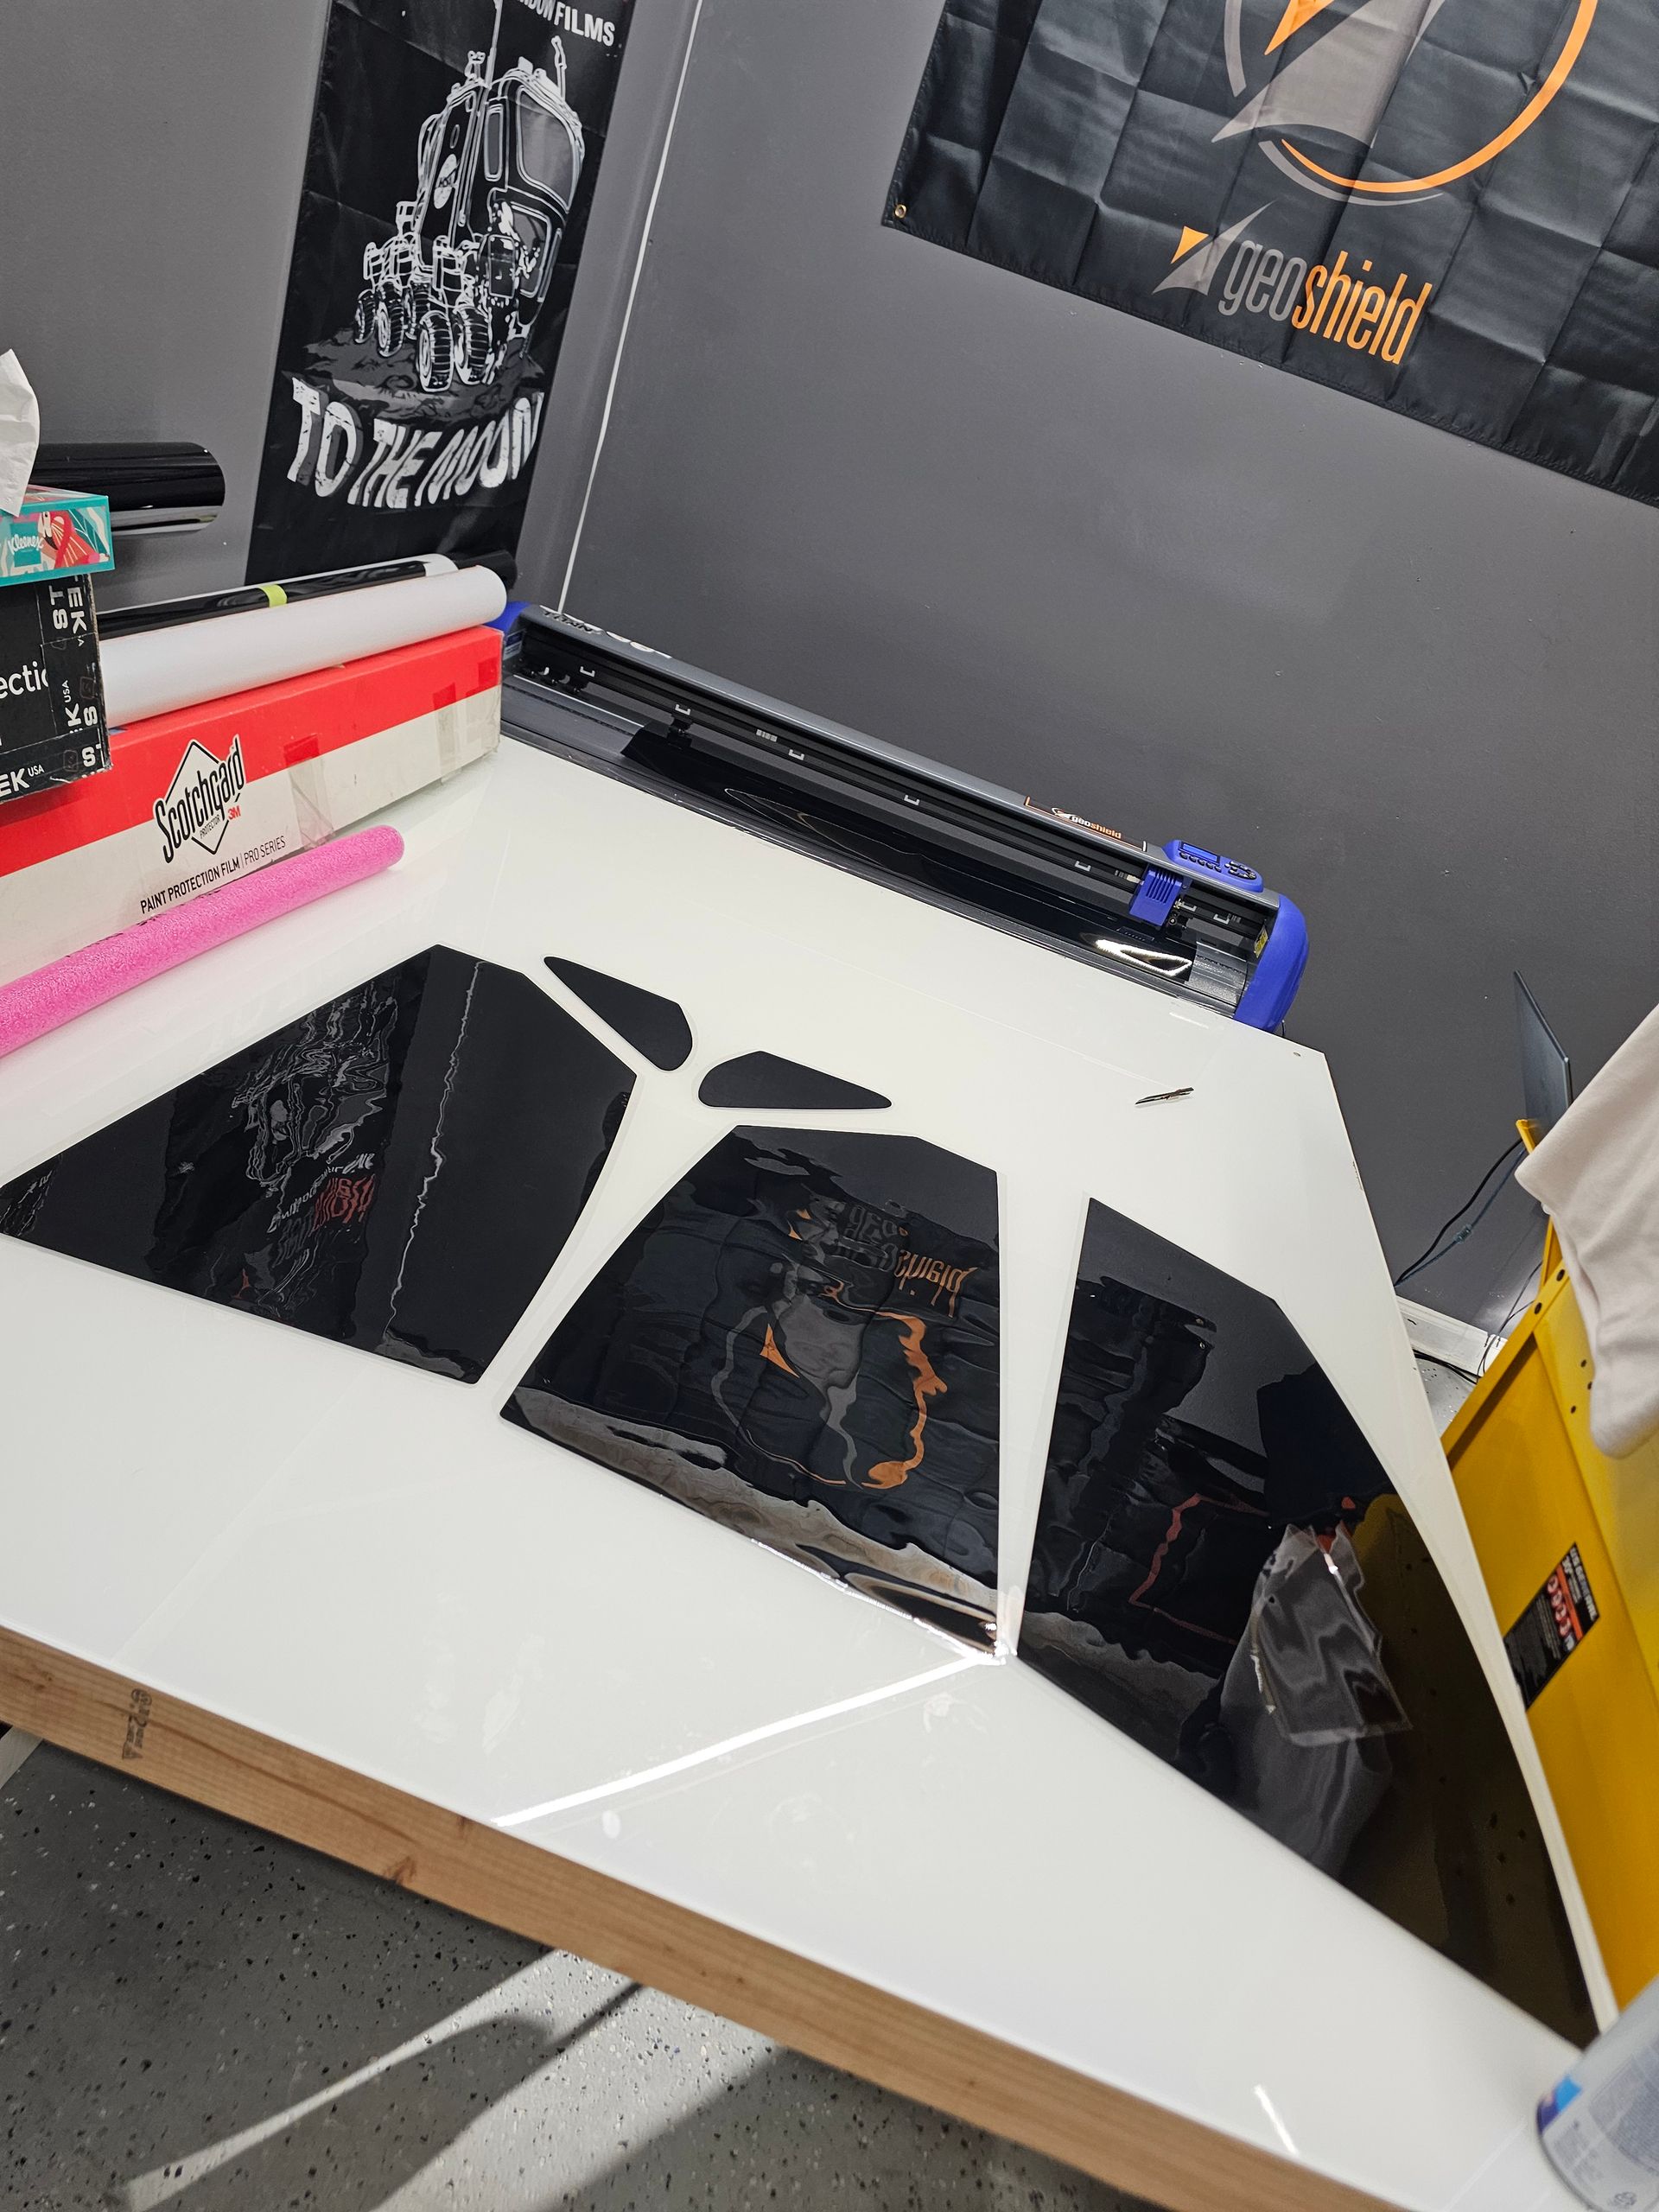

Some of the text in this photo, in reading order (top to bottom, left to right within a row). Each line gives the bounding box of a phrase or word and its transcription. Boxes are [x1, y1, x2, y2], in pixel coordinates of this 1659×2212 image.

[553, 2, 615, 47] FILMS
[1217, 240, 1433, 365] geoshield
[287, 377, 545, 509] TO THE MOON
[8, 534, 44, 556] Kleenex
[67, 575, 87, 634] EK
[62, 680, 72, 703] USA
[27, 764, 45, 778] USA
[155, 736, 245, 864] Scotchgard
[227, 804, 241, 820] 3M
[1071, 815, 1122, 840] geoshield
[140, 835, 286, 914] PAINT PROTECTION FILM PRO SERIES
